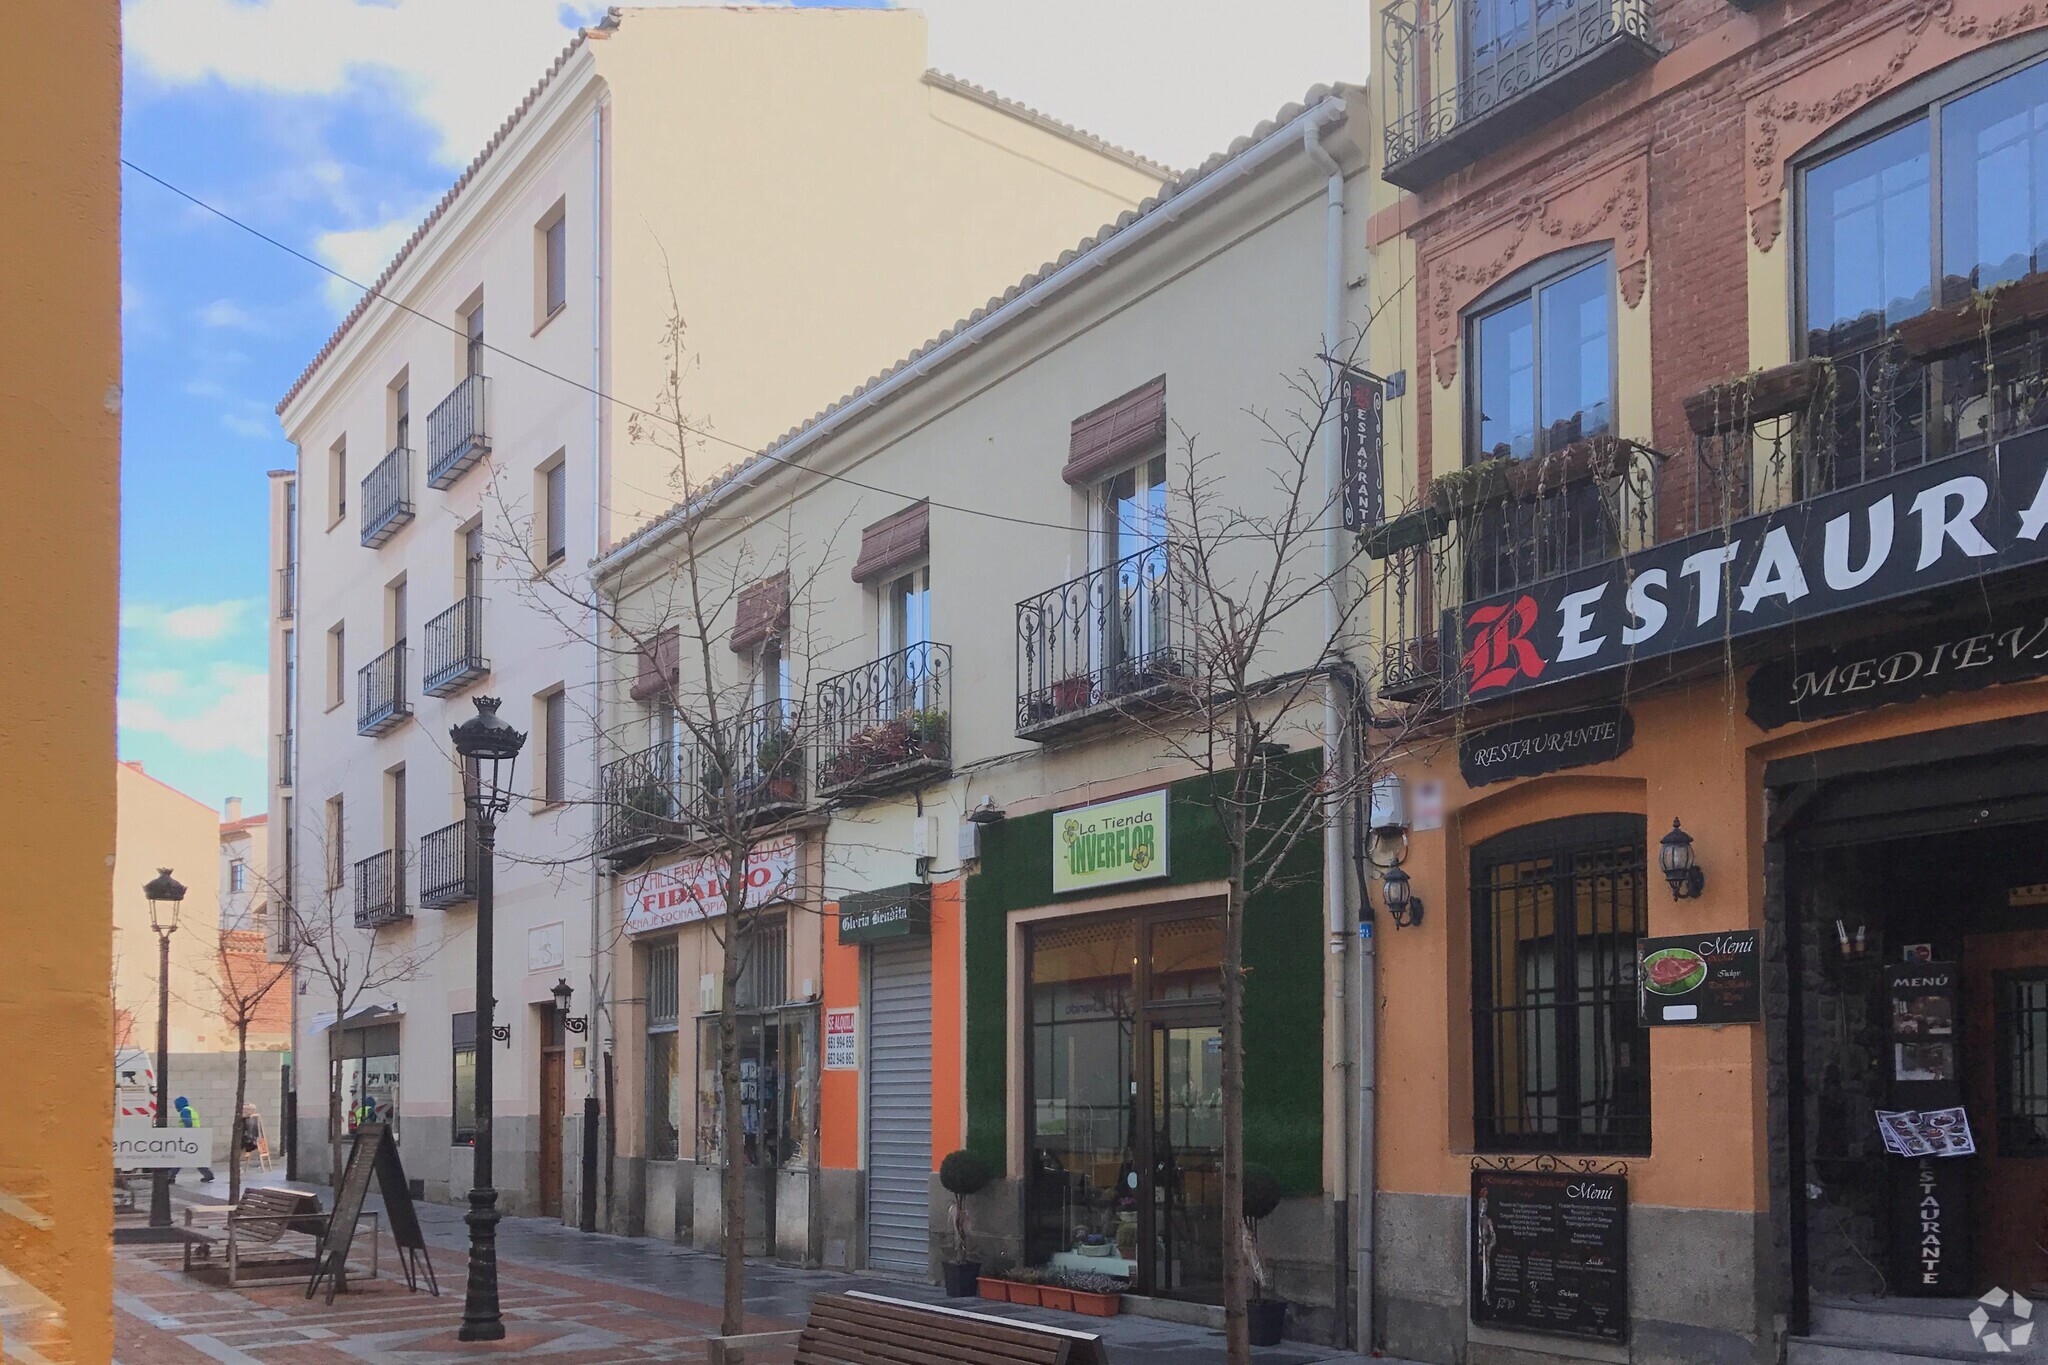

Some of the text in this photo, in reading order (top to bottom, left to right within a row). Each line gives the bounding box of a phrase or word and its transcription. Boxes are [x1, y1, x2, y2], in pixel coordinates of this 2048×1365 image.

[1354, 384, 1371, 528] RESTAURANT
[1789, 617, 2048, 705] MEDIEV
[1474, 722, 1616, 767] RESTAURANTE
[1079, 811, 1153, 835] La Tienda
[1070, 824, 1154, 875] INVERFLOR
[872, 907, 908, 926] Bendita
[1698, 936, 1754, 956] Menú
[1893, 974, 1949, 987] MENÚ
[1566, 1182, 1614, 1200] Menú
[1919, 1159, 1942, 1285] ESTAURANTE
